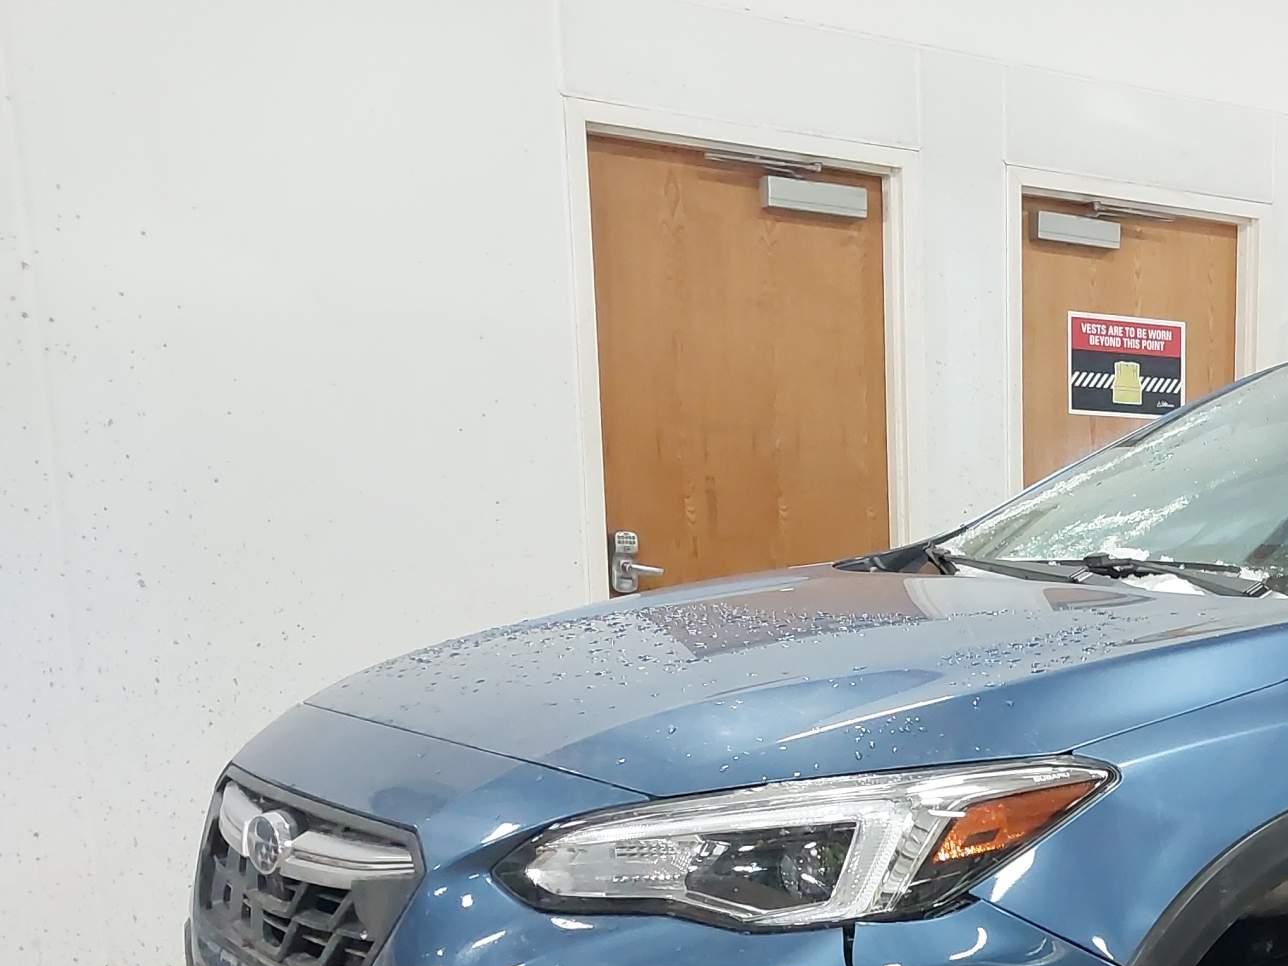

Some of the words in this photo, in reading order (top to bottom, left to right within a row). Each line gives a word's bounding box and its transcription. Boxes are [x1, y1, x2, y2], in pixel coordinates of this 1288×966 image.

[1081, 322, 1107, 334] VESTS
[1107, 325, 1123, 337] ARE
[1125, 327, 1136, 337] TO
[1137, 328, 1148, 339] BE
[1148, 330, 1172, 341] WORN
[1089, 335, 1121, 347] BEYOND
[1123, 337, 1140, 349] THIS
[1141, 339, 1165, 351] POINT
